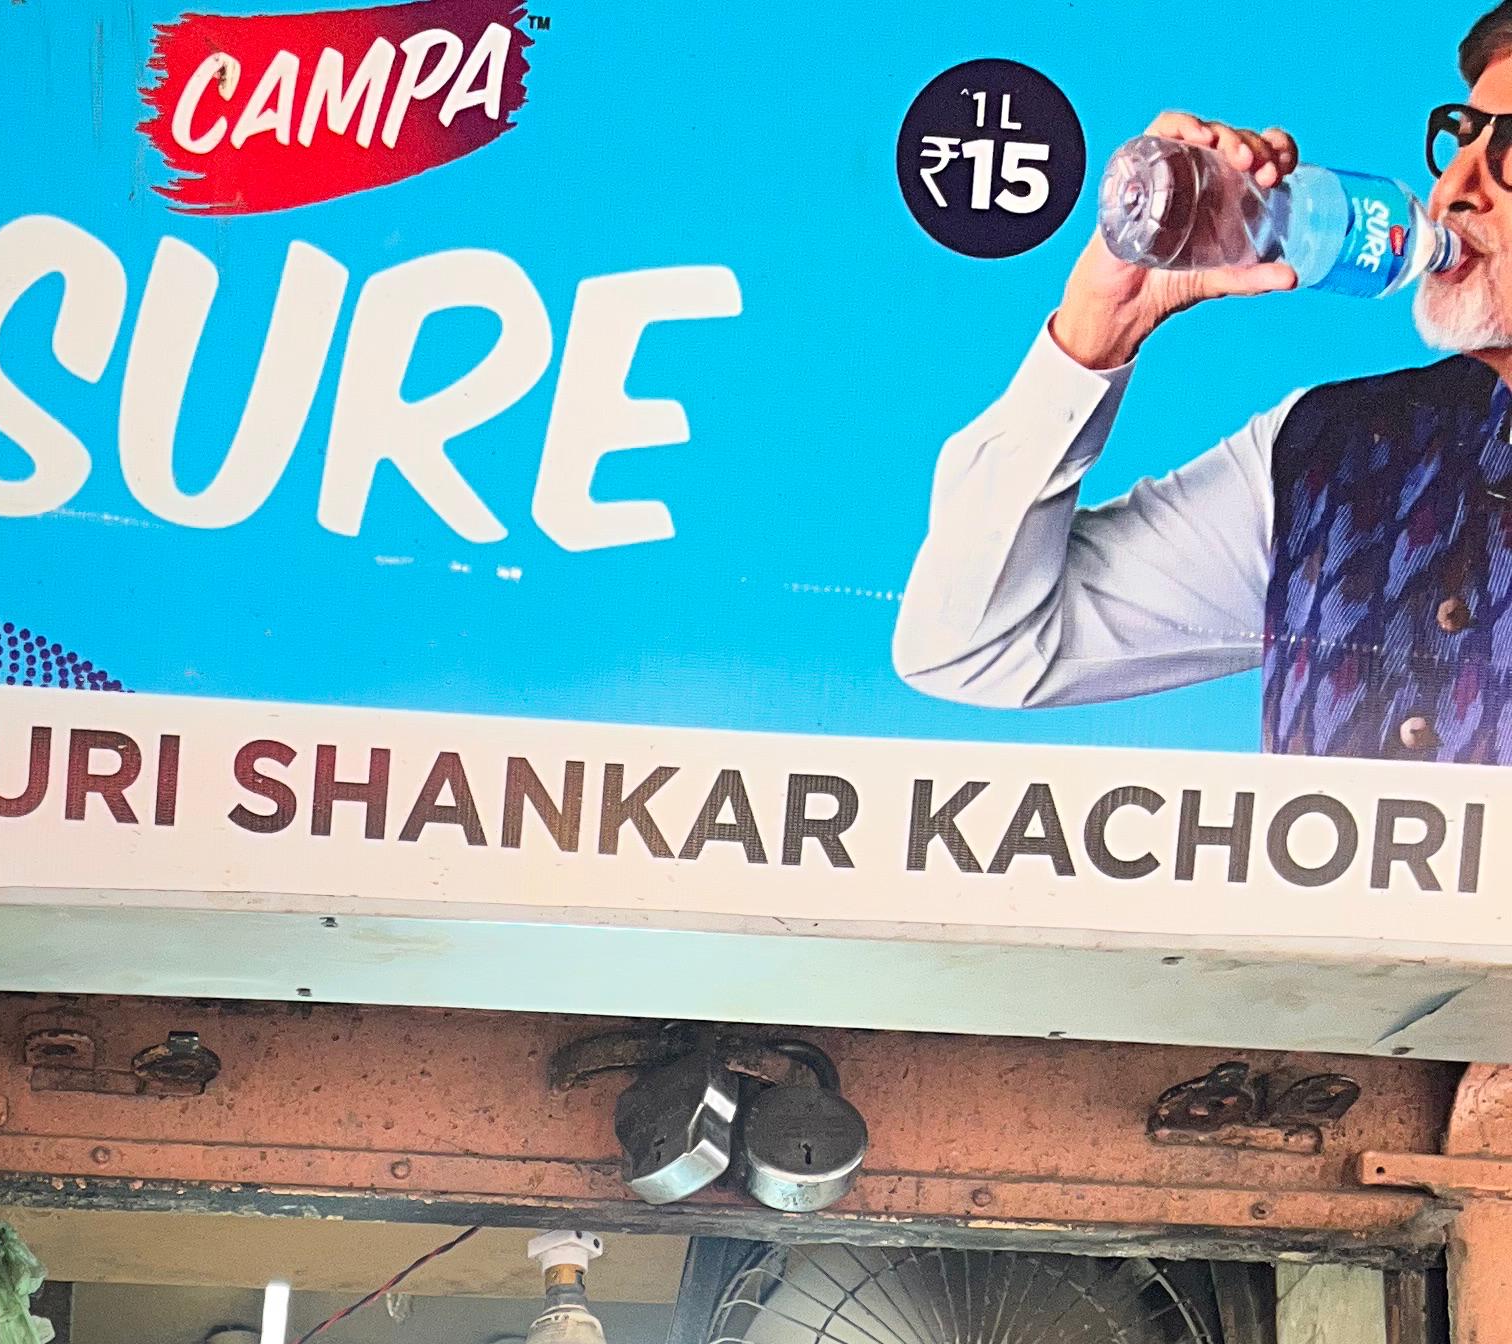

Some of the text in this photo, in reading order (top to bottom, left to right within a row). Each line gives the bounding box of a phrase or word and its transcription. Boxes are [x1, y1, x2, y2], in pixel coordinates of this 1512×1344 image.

[170, 22, 508, 155] CAMPA
[1000, 93, 1022, 130] L
[920, 136, 1050, 214] ₹15
[1355, 198, 1390, 273] SURE
[226, 737, 863, 872] SHANKAR
[905, 779, 1486, 895] KACHORI
